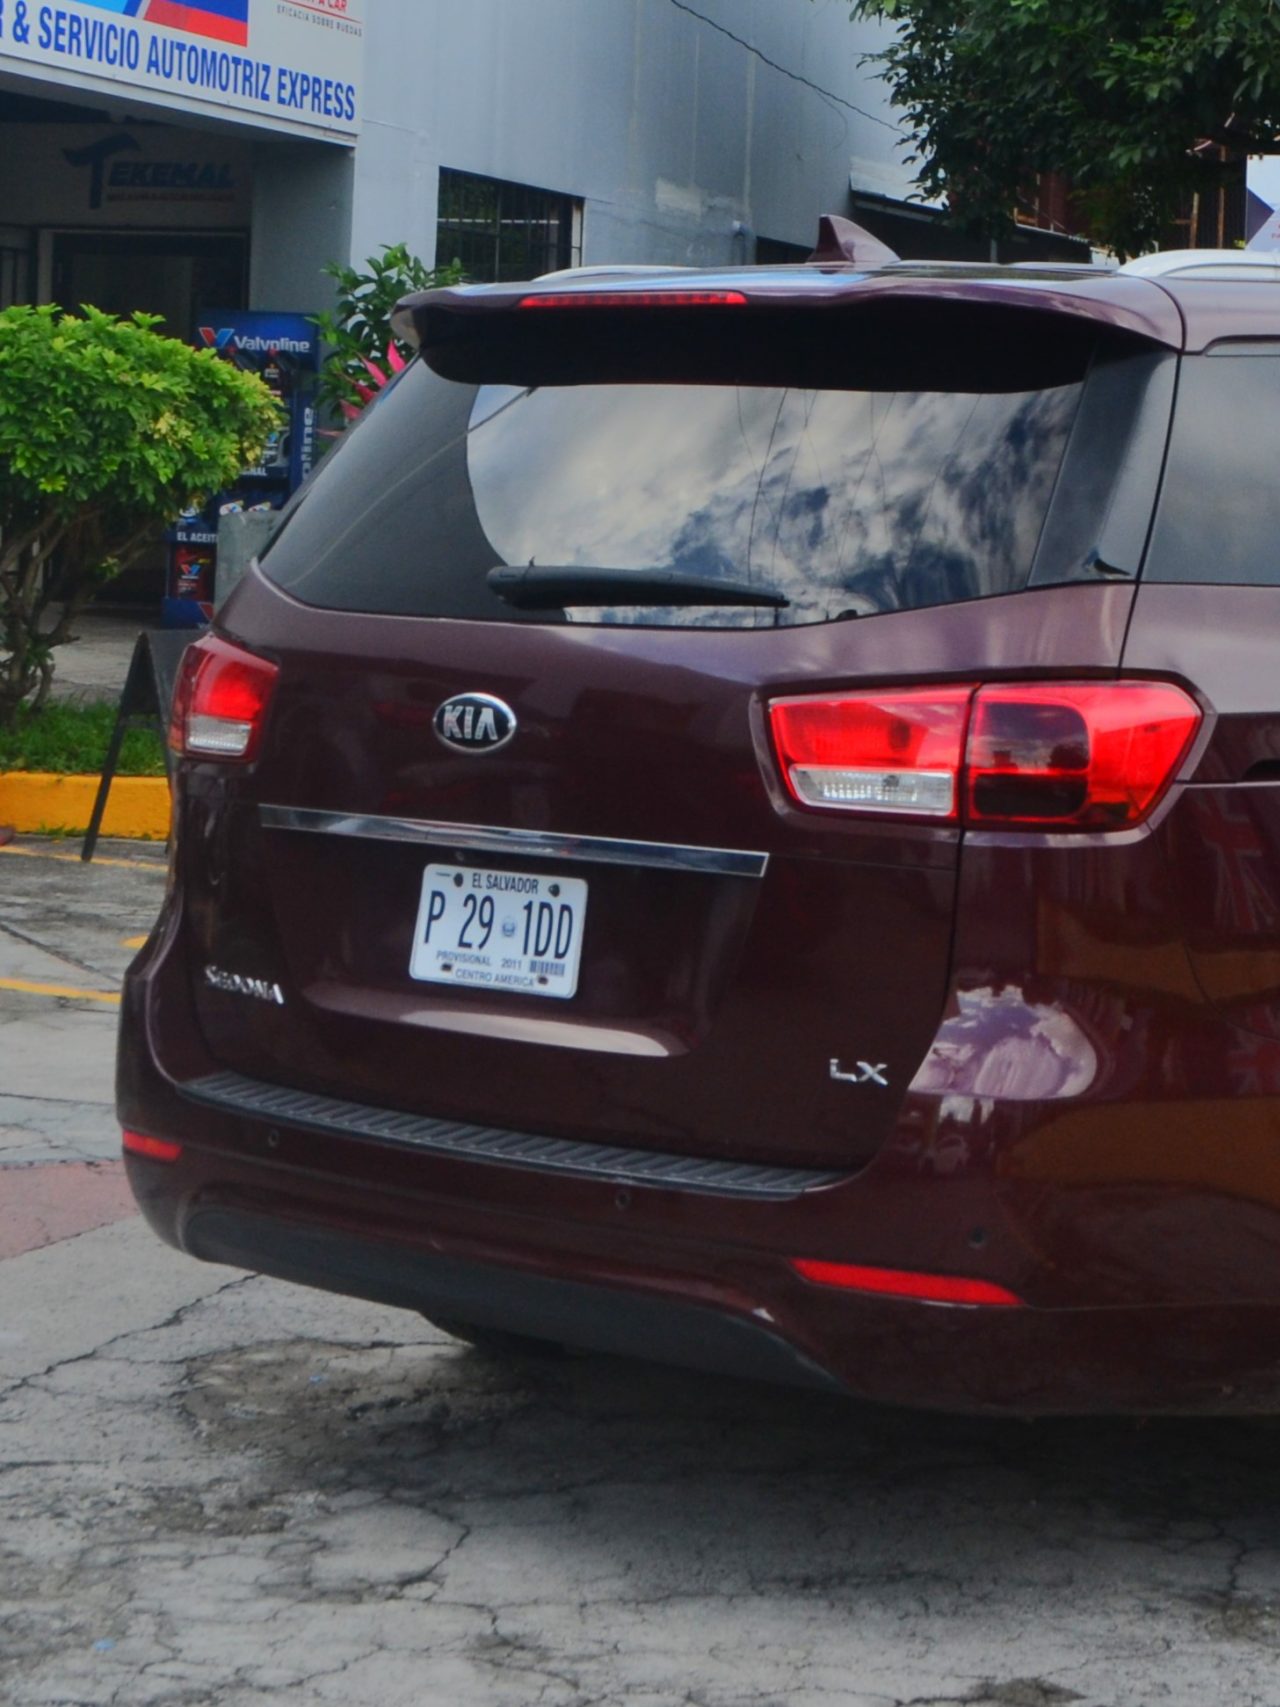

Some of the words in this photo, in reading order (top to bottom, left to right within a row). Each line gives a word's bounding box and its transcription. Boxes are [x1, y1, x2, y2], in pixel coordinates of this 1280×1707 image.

[276, 4, 310, 21] EFICACIA
[311, 14, 334, 30] SOBRE
[336, 21, 362, 38] RUEDAS
[13, 0, 30, 44] &
[37, 6, 140, 71] SERVICIO
[147, 35, 270, 103] AUTOMOTRIZ
[277, 68, 356, 121] EXPRESS
[62, 131, 236, 209] TEKEMAL
[233, 335, 310, 353] Valvoline
[190, 532, 219, 544] ACEIT
[443, 704, 499, 741] KIA
[472, 872, 482, 889] EL
[485, 874, 539, 894] SALVADOR
[424, 890, 446, 944] P
[457, 893, 495, 950] 29
[436, 950, 491, 966] PROVISIONAL
[501, 958, 523, 970] 2011
[455, 968, 493, 983] CENTRO
[494, 974, 534, 988] AMERICA
[829, 1058, 889, 1086] LX
